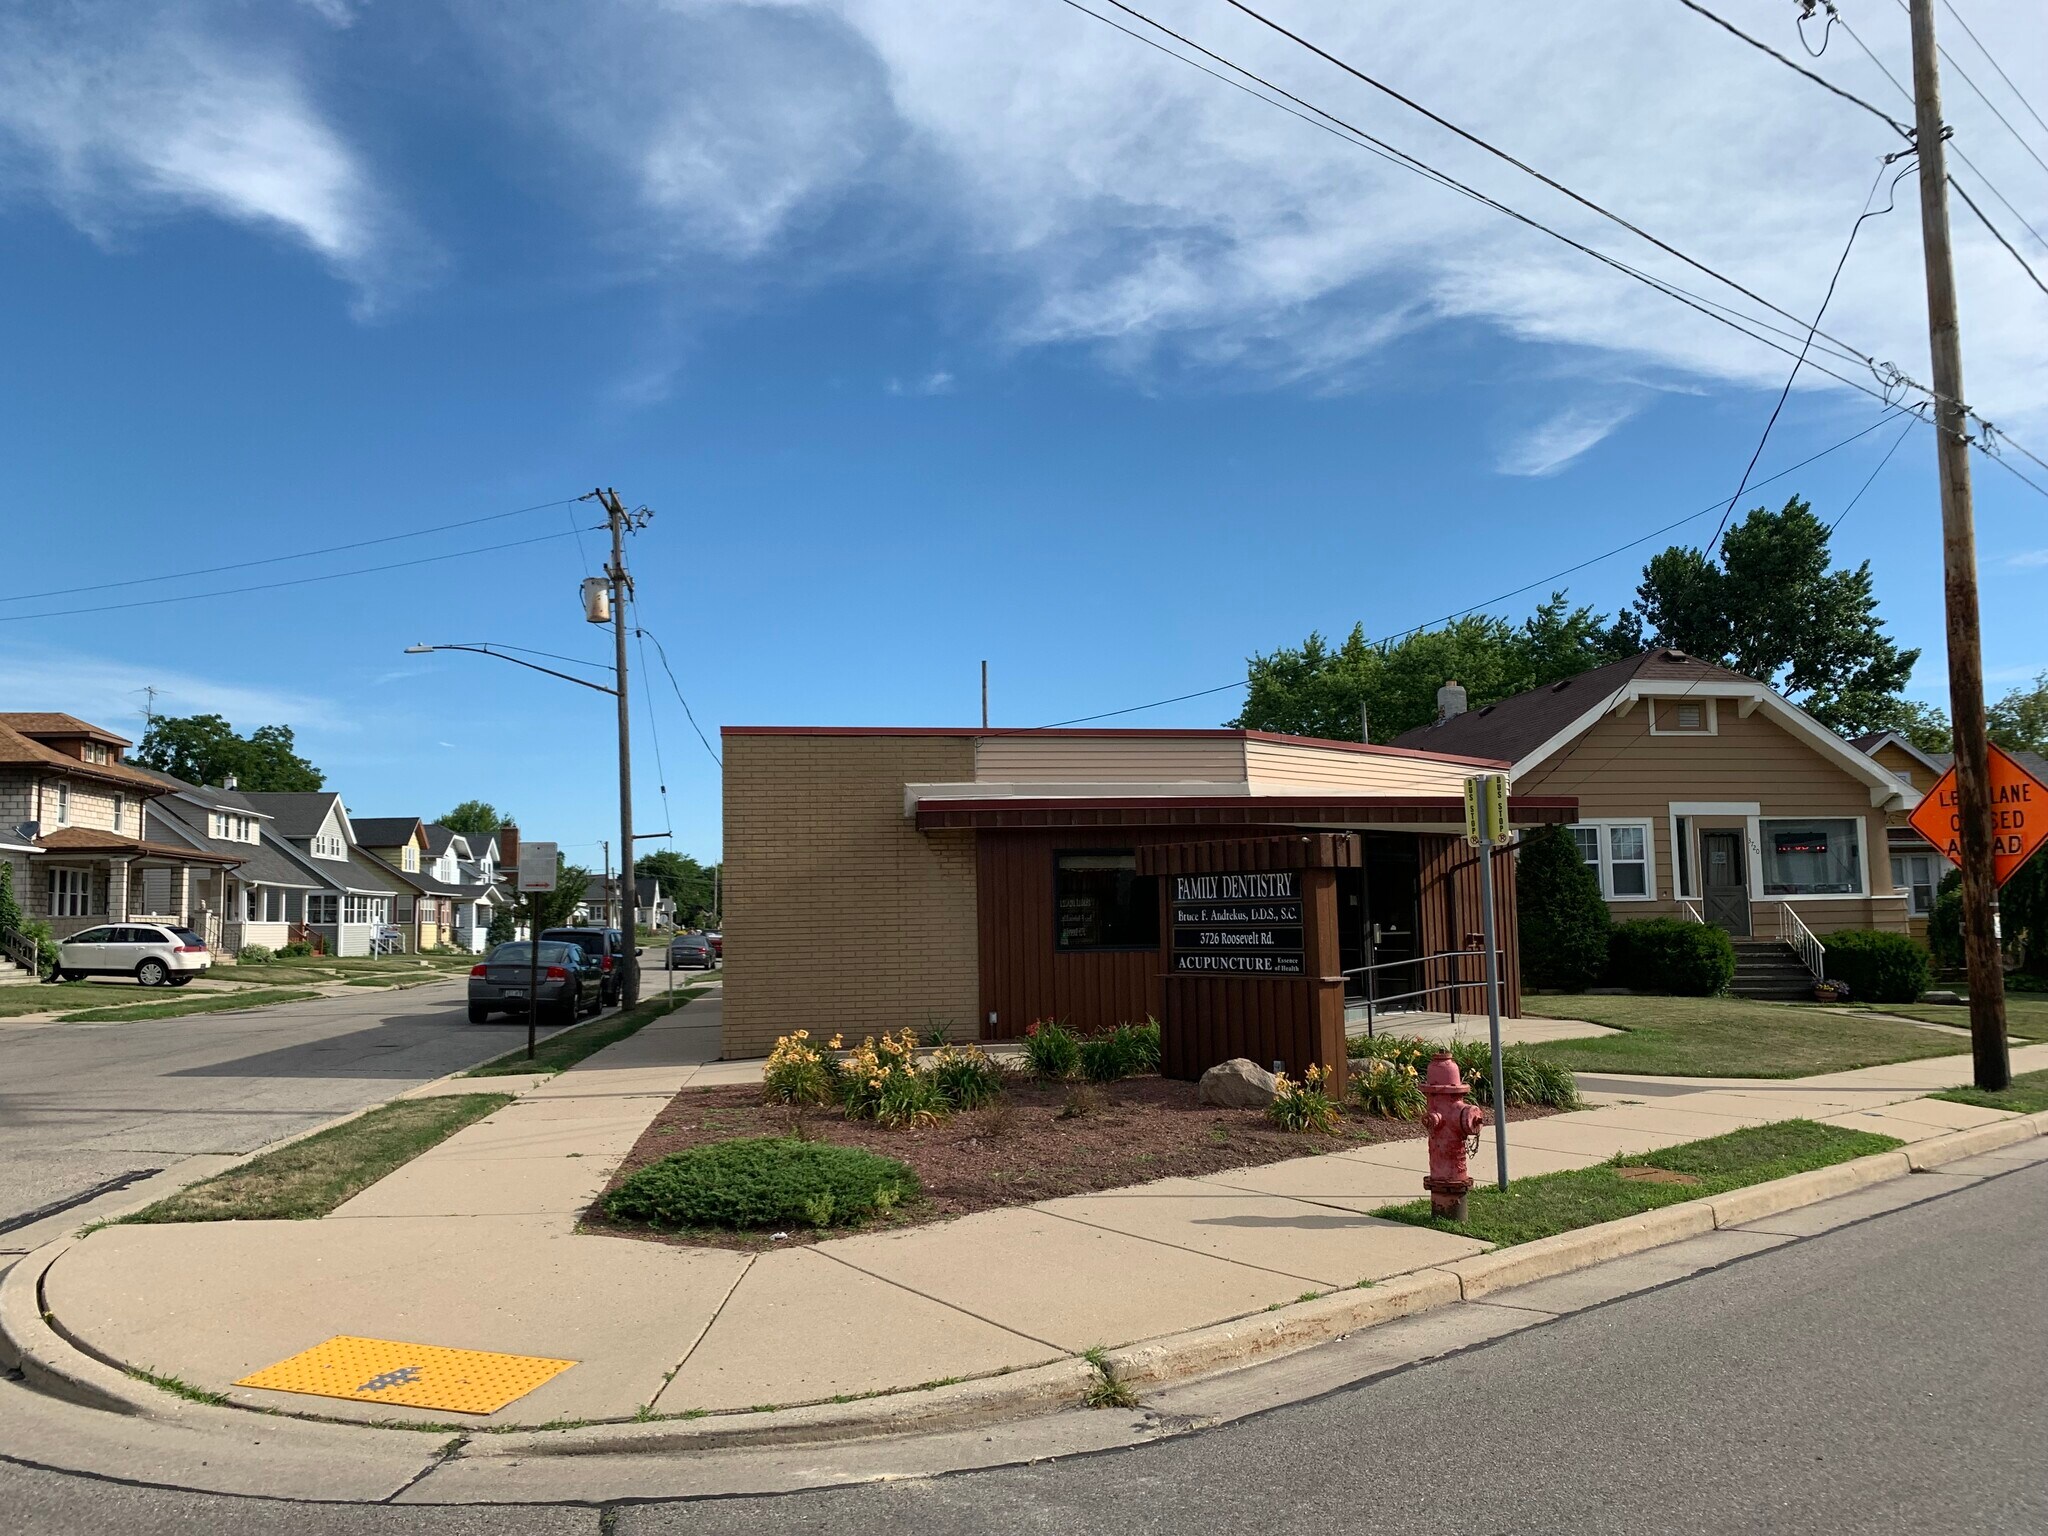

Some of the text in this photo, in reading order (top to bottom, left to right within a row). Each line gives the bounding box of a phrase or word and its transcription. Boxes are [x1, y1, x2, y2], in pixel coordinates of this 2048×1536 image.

[1990, 783, 2032, 804] LANE
[1950, 810, 2025, 832] CSED
[1947, 835, 2022, 857] AAD
[1177, 872, 1293, 900] FAMILY DENTISTRY
[1178, 907, 1297, 922] Bruce F. Andrekus, D.D.S., S.C.
[1200, 931, 1275, 945] 3726 Roosevelt Rd.
[1178, 956, 1273, 971] ACUPUNCTURE
[1277, 956, 1299, 964] Essence
[1274, 964, 1280, 972] of
